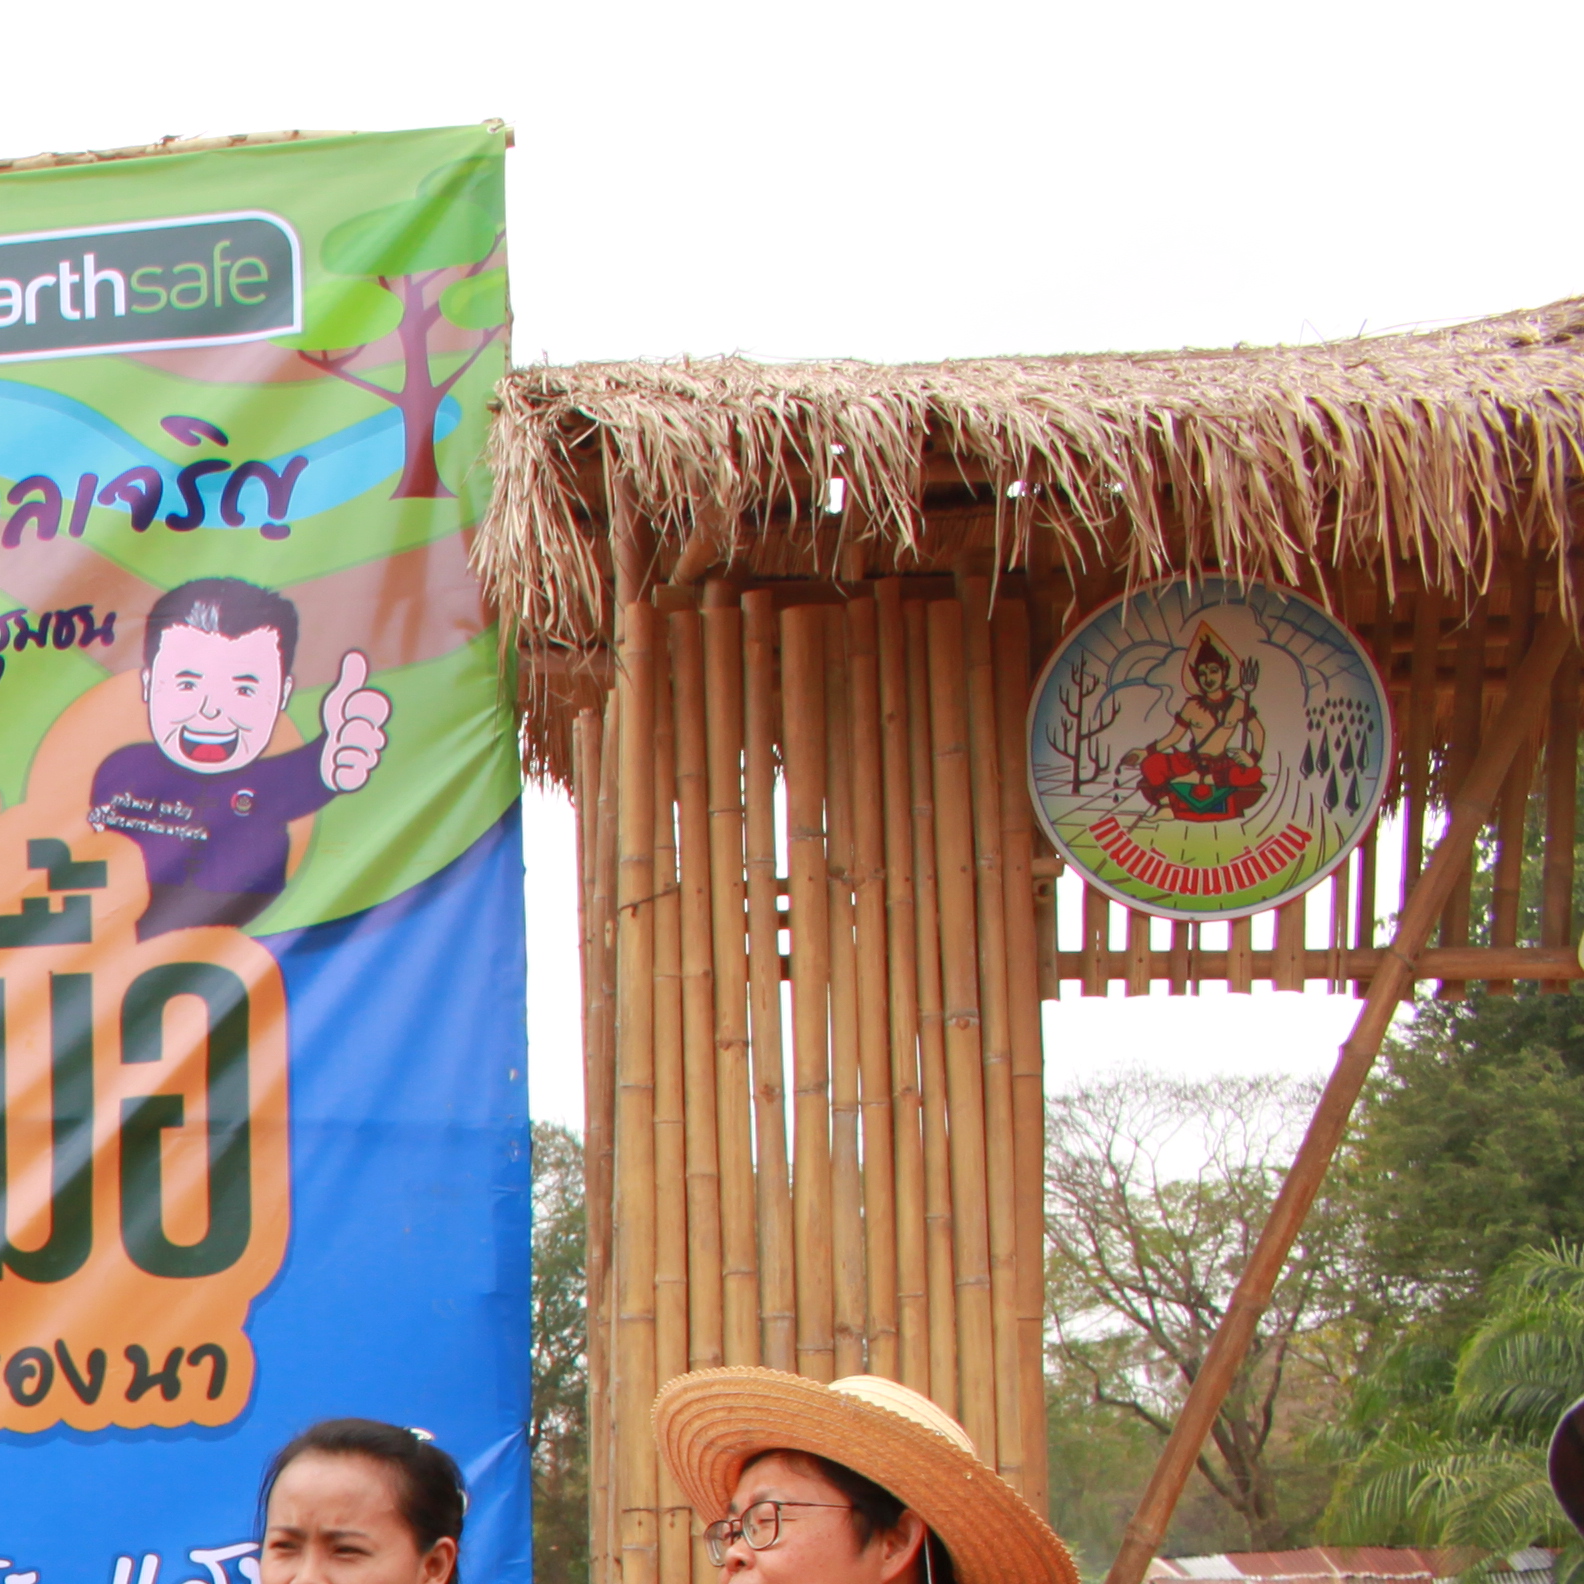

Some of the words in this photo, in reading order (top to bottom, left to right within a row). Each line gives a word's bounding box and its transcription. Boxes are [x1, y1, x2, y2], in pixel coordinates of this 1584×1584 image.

[1088, 815, 1313, 896] กรมพัฒนาที่ดิน
